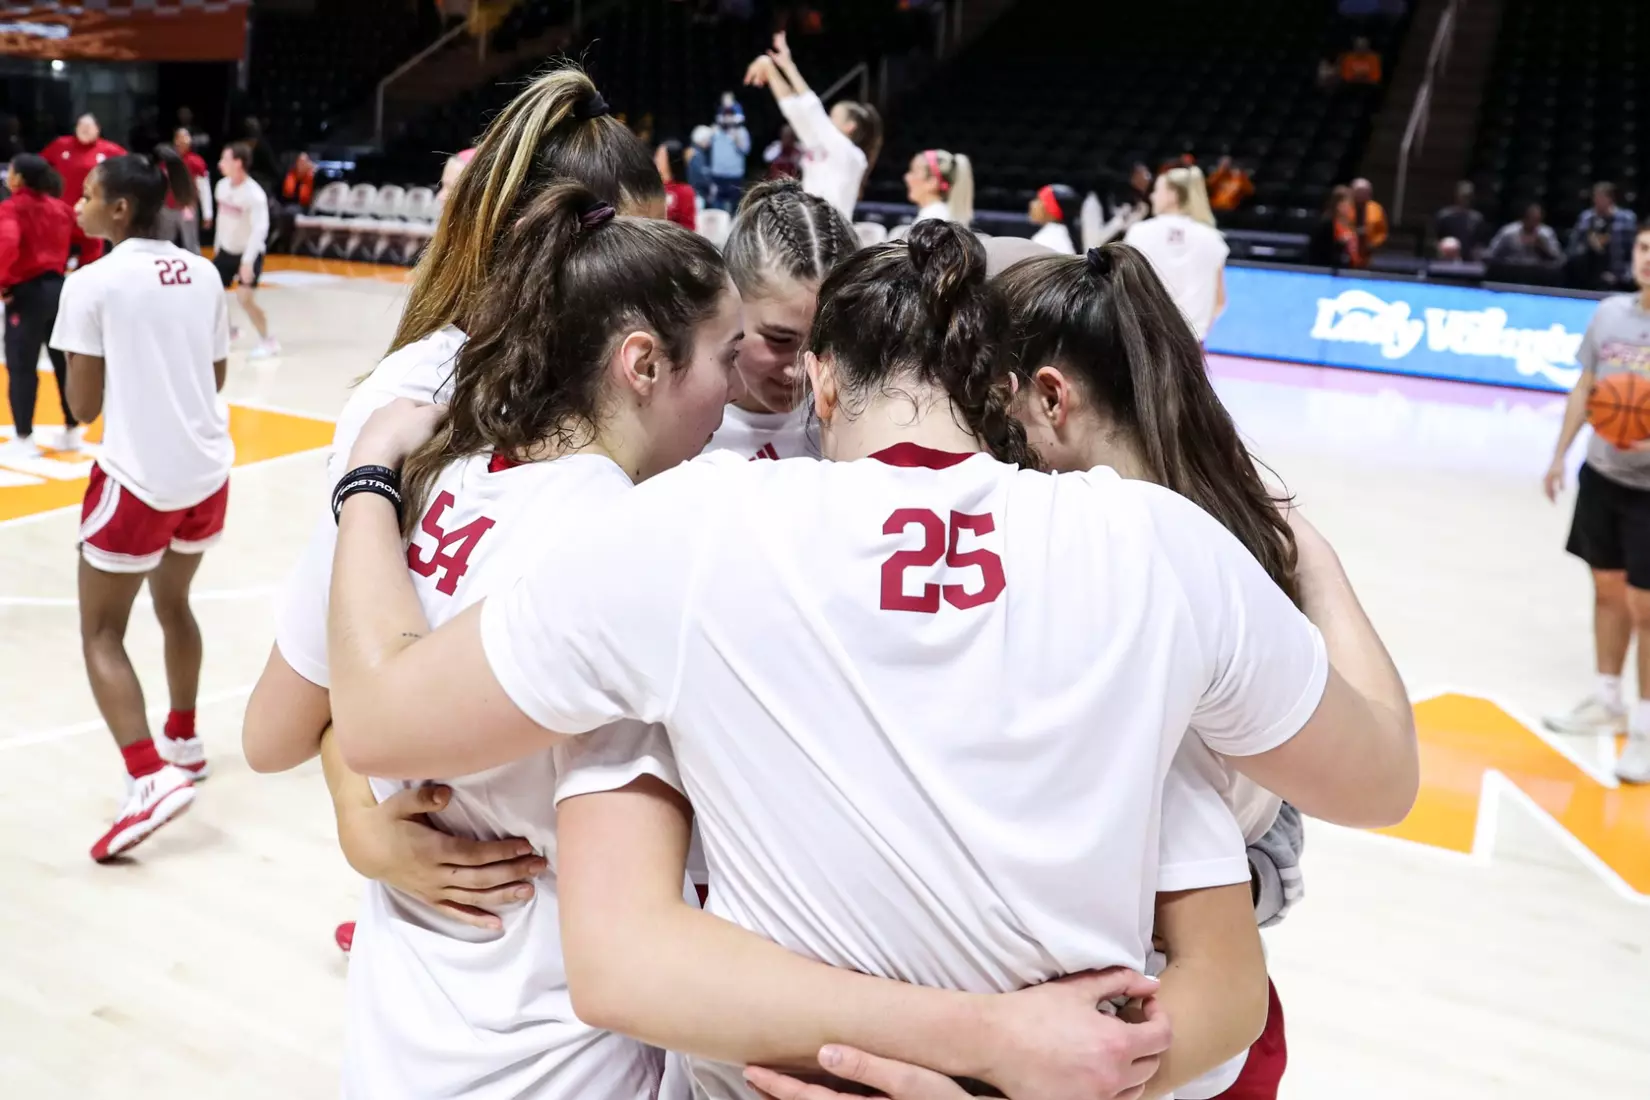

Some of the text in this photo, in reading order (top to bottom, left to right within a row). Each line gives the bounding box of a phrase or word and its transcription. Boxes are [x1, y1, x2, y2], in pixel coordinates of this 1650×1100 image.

[155, 260, 191, 285] 22
[406, 490, 496, 597] 54
[880, 508, 1006, 613] 25
